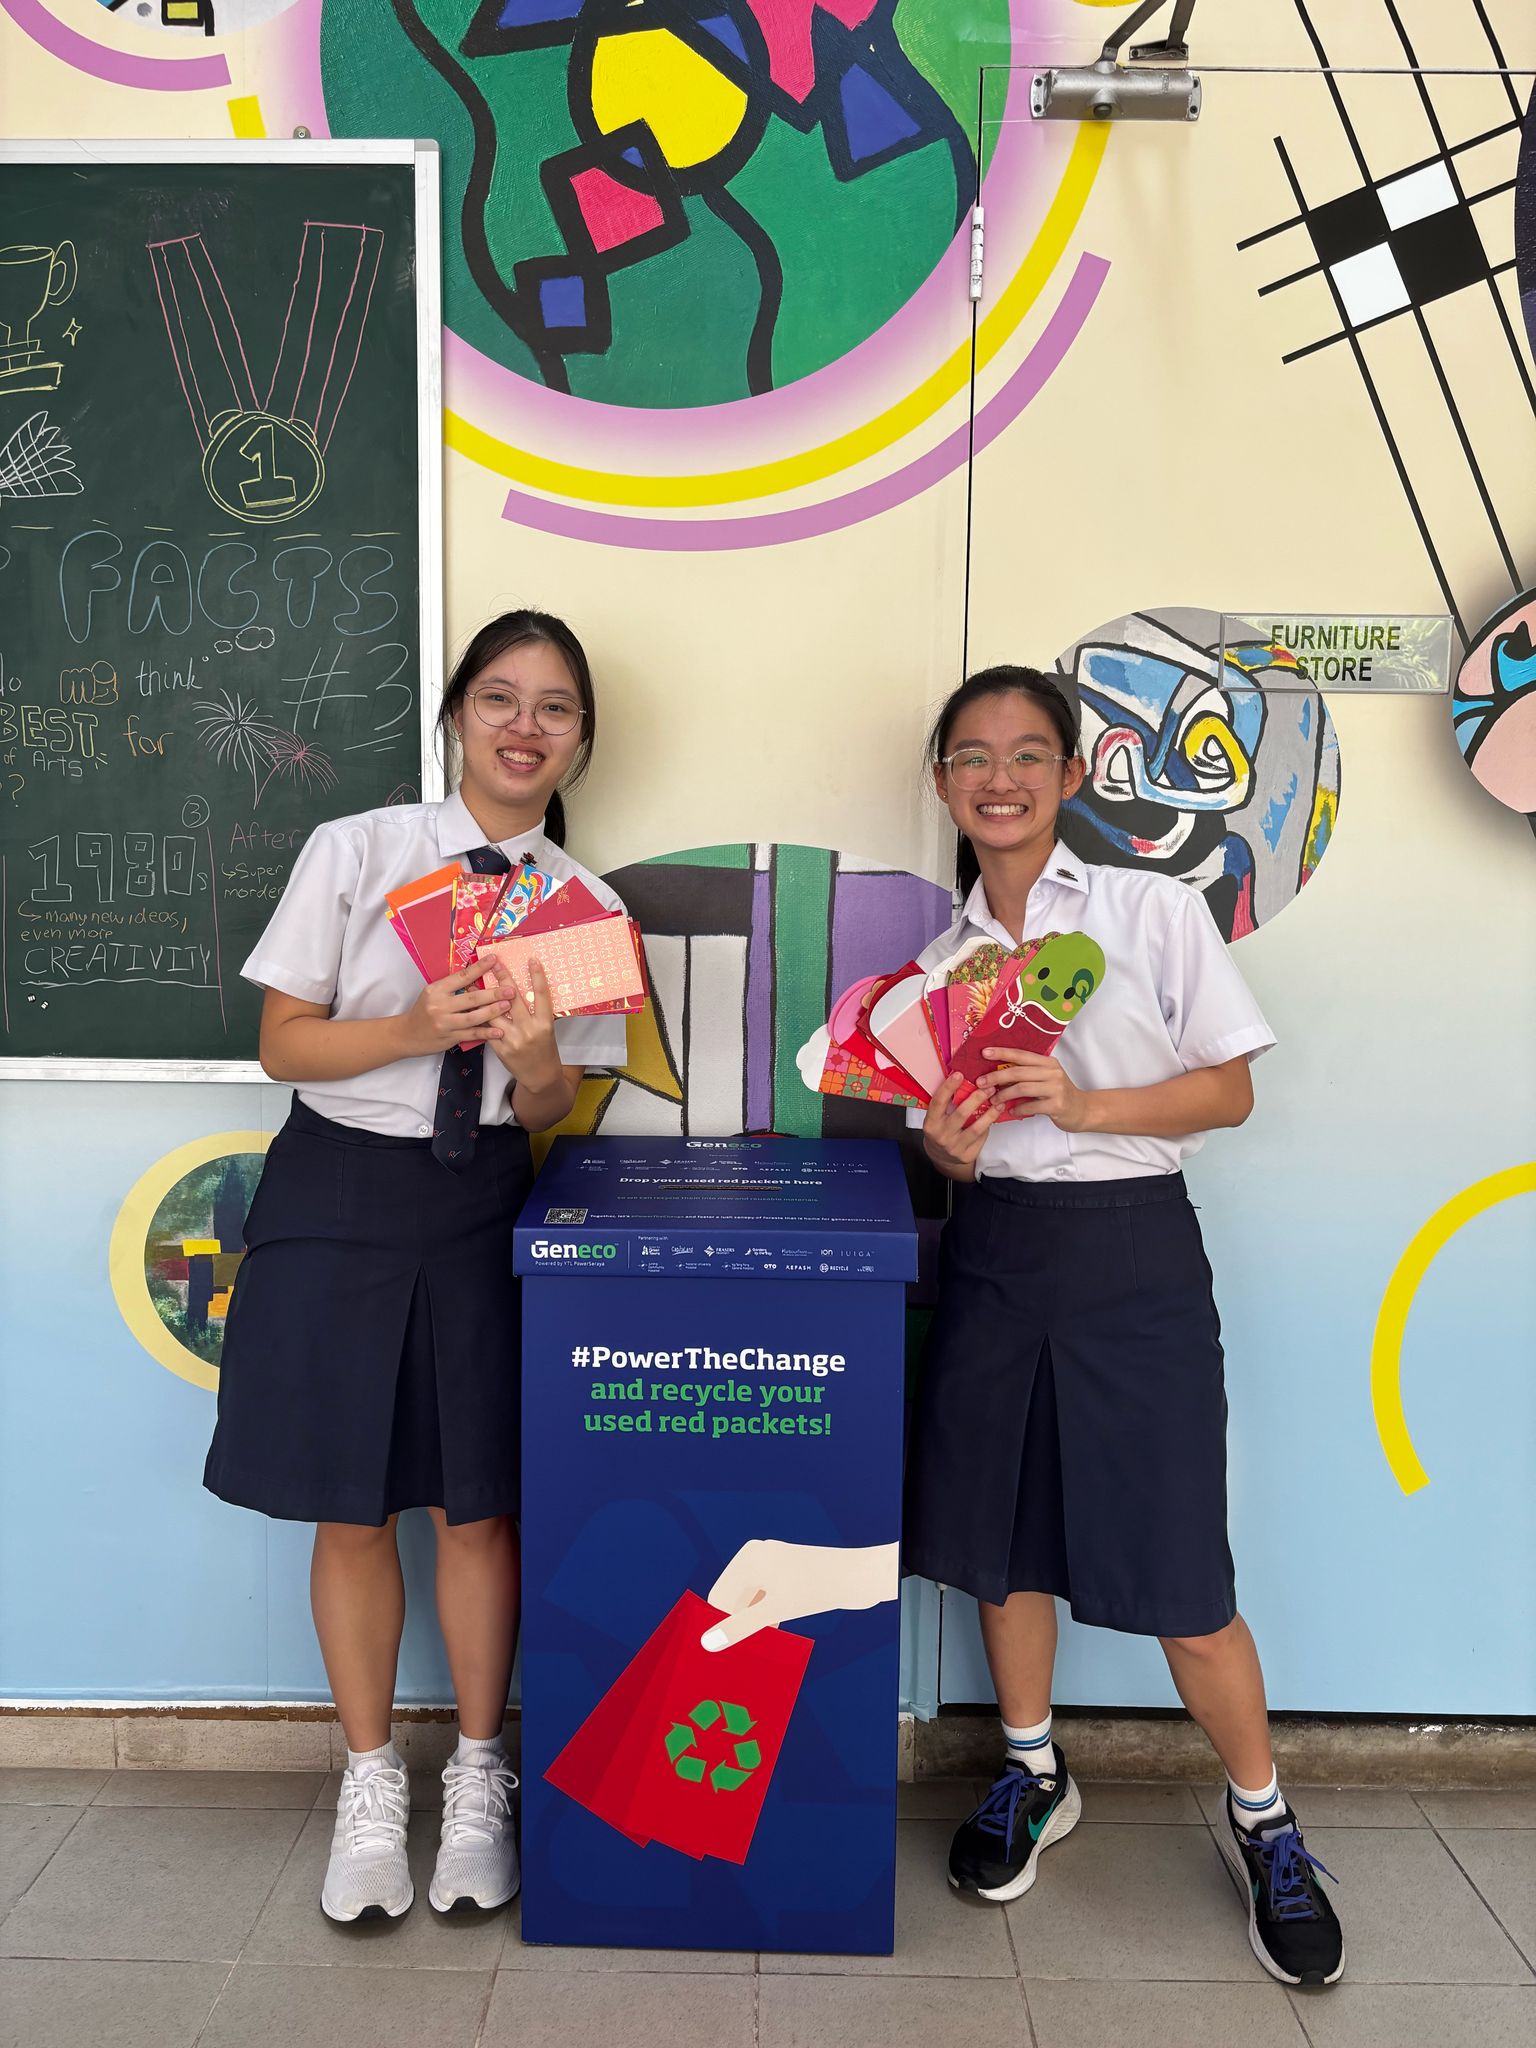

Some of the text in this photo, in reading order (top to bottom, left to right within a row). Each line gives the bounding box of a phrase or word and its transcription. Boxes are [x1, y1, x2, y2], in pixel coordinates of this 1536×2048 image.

[239, 424, 297, 508] 1
[60, 530, 399, 644] FACTS
[1271, 625, 1401, 650] FURNITURE
[136, 657, 204, 697] think
[1296, 656, 1373, 682] STORE
[281, 642, 413, 735] #3
[0, 702, 175, 758] BEST for
[33, 750, 83, 777] Arts
[230, 821, 302, 854] After
[235, 862, 284, 885] Super
[45, 909, 89, 927] many
[91, 911, 124, 925] new
[20, 929, 114, 942] even more
[24, 943, 211, 985] CREATIVITY
[686, 1141, 762, 1149] Geneco
[531, 1240, 617, 1259] Geneco
[572, 1346, 846, 1377] #PowerTheChange
[590, 1378, 826, 1408] and recycle your
[584, 1410, 832, 1439] used red packets!
